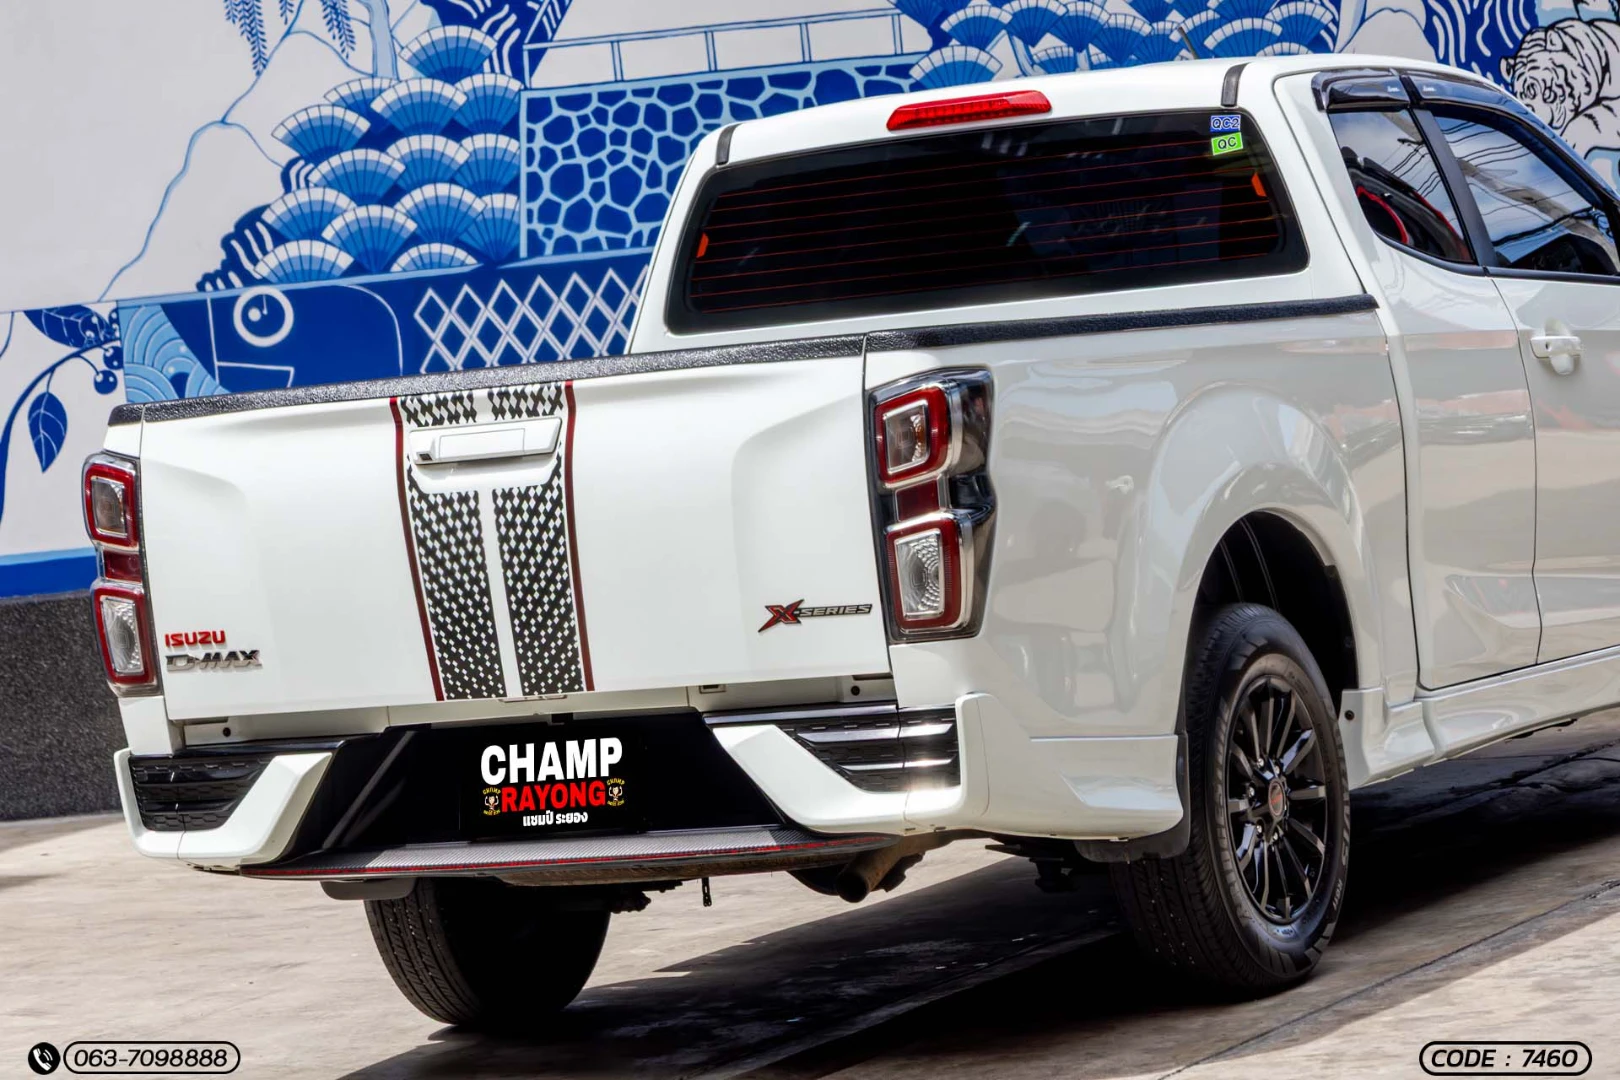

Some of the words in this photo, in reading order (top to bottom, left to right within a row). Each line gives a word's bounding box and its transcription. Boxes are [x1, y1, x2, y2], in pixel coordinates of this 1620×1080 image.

[1212, 118, 1239, 130] QC2
[1217, 136, 1237, 149] QC
[164, 629, 226, 648] ISUZU
[165, 649, 263, 672] D-MAX
[481, 737, 623, 786] CHAMP
[502, 780, 606, 812] RAYONG
[555, 812, 588, 825] ระยอง
